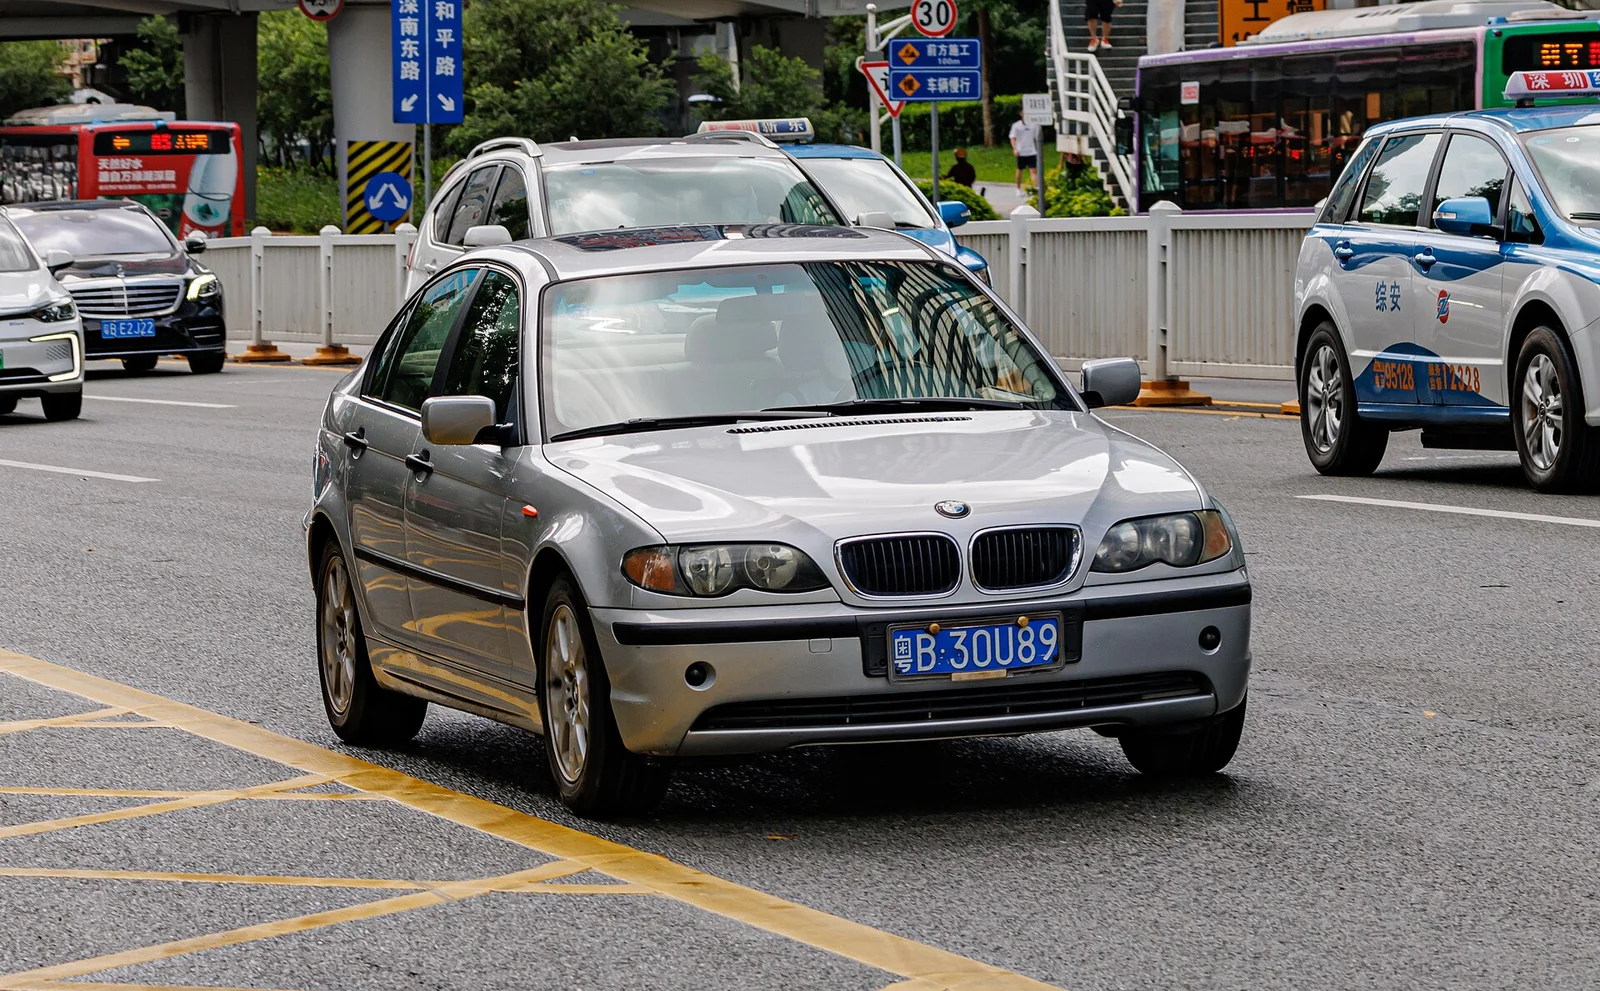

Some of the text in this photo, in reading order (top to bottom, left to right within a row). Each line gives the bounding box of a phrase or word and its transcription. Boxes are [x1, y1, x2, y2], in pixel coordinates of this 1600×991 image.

[919, 1, 950, 26] 30
[399, 0, 420, 80] 深南东路
[435, 1, 456, 76] 和平路
[926, 43, 970, 57] 前方施工
[927, 77, 971, 93] 车辆慢行
[1528, 72, 1585, 89] 深圳
[1375, 280, 1401, 312] 综安
[1385, 362, 1414, 390] 95128
[1442, 364, 1480, 393] 12328
